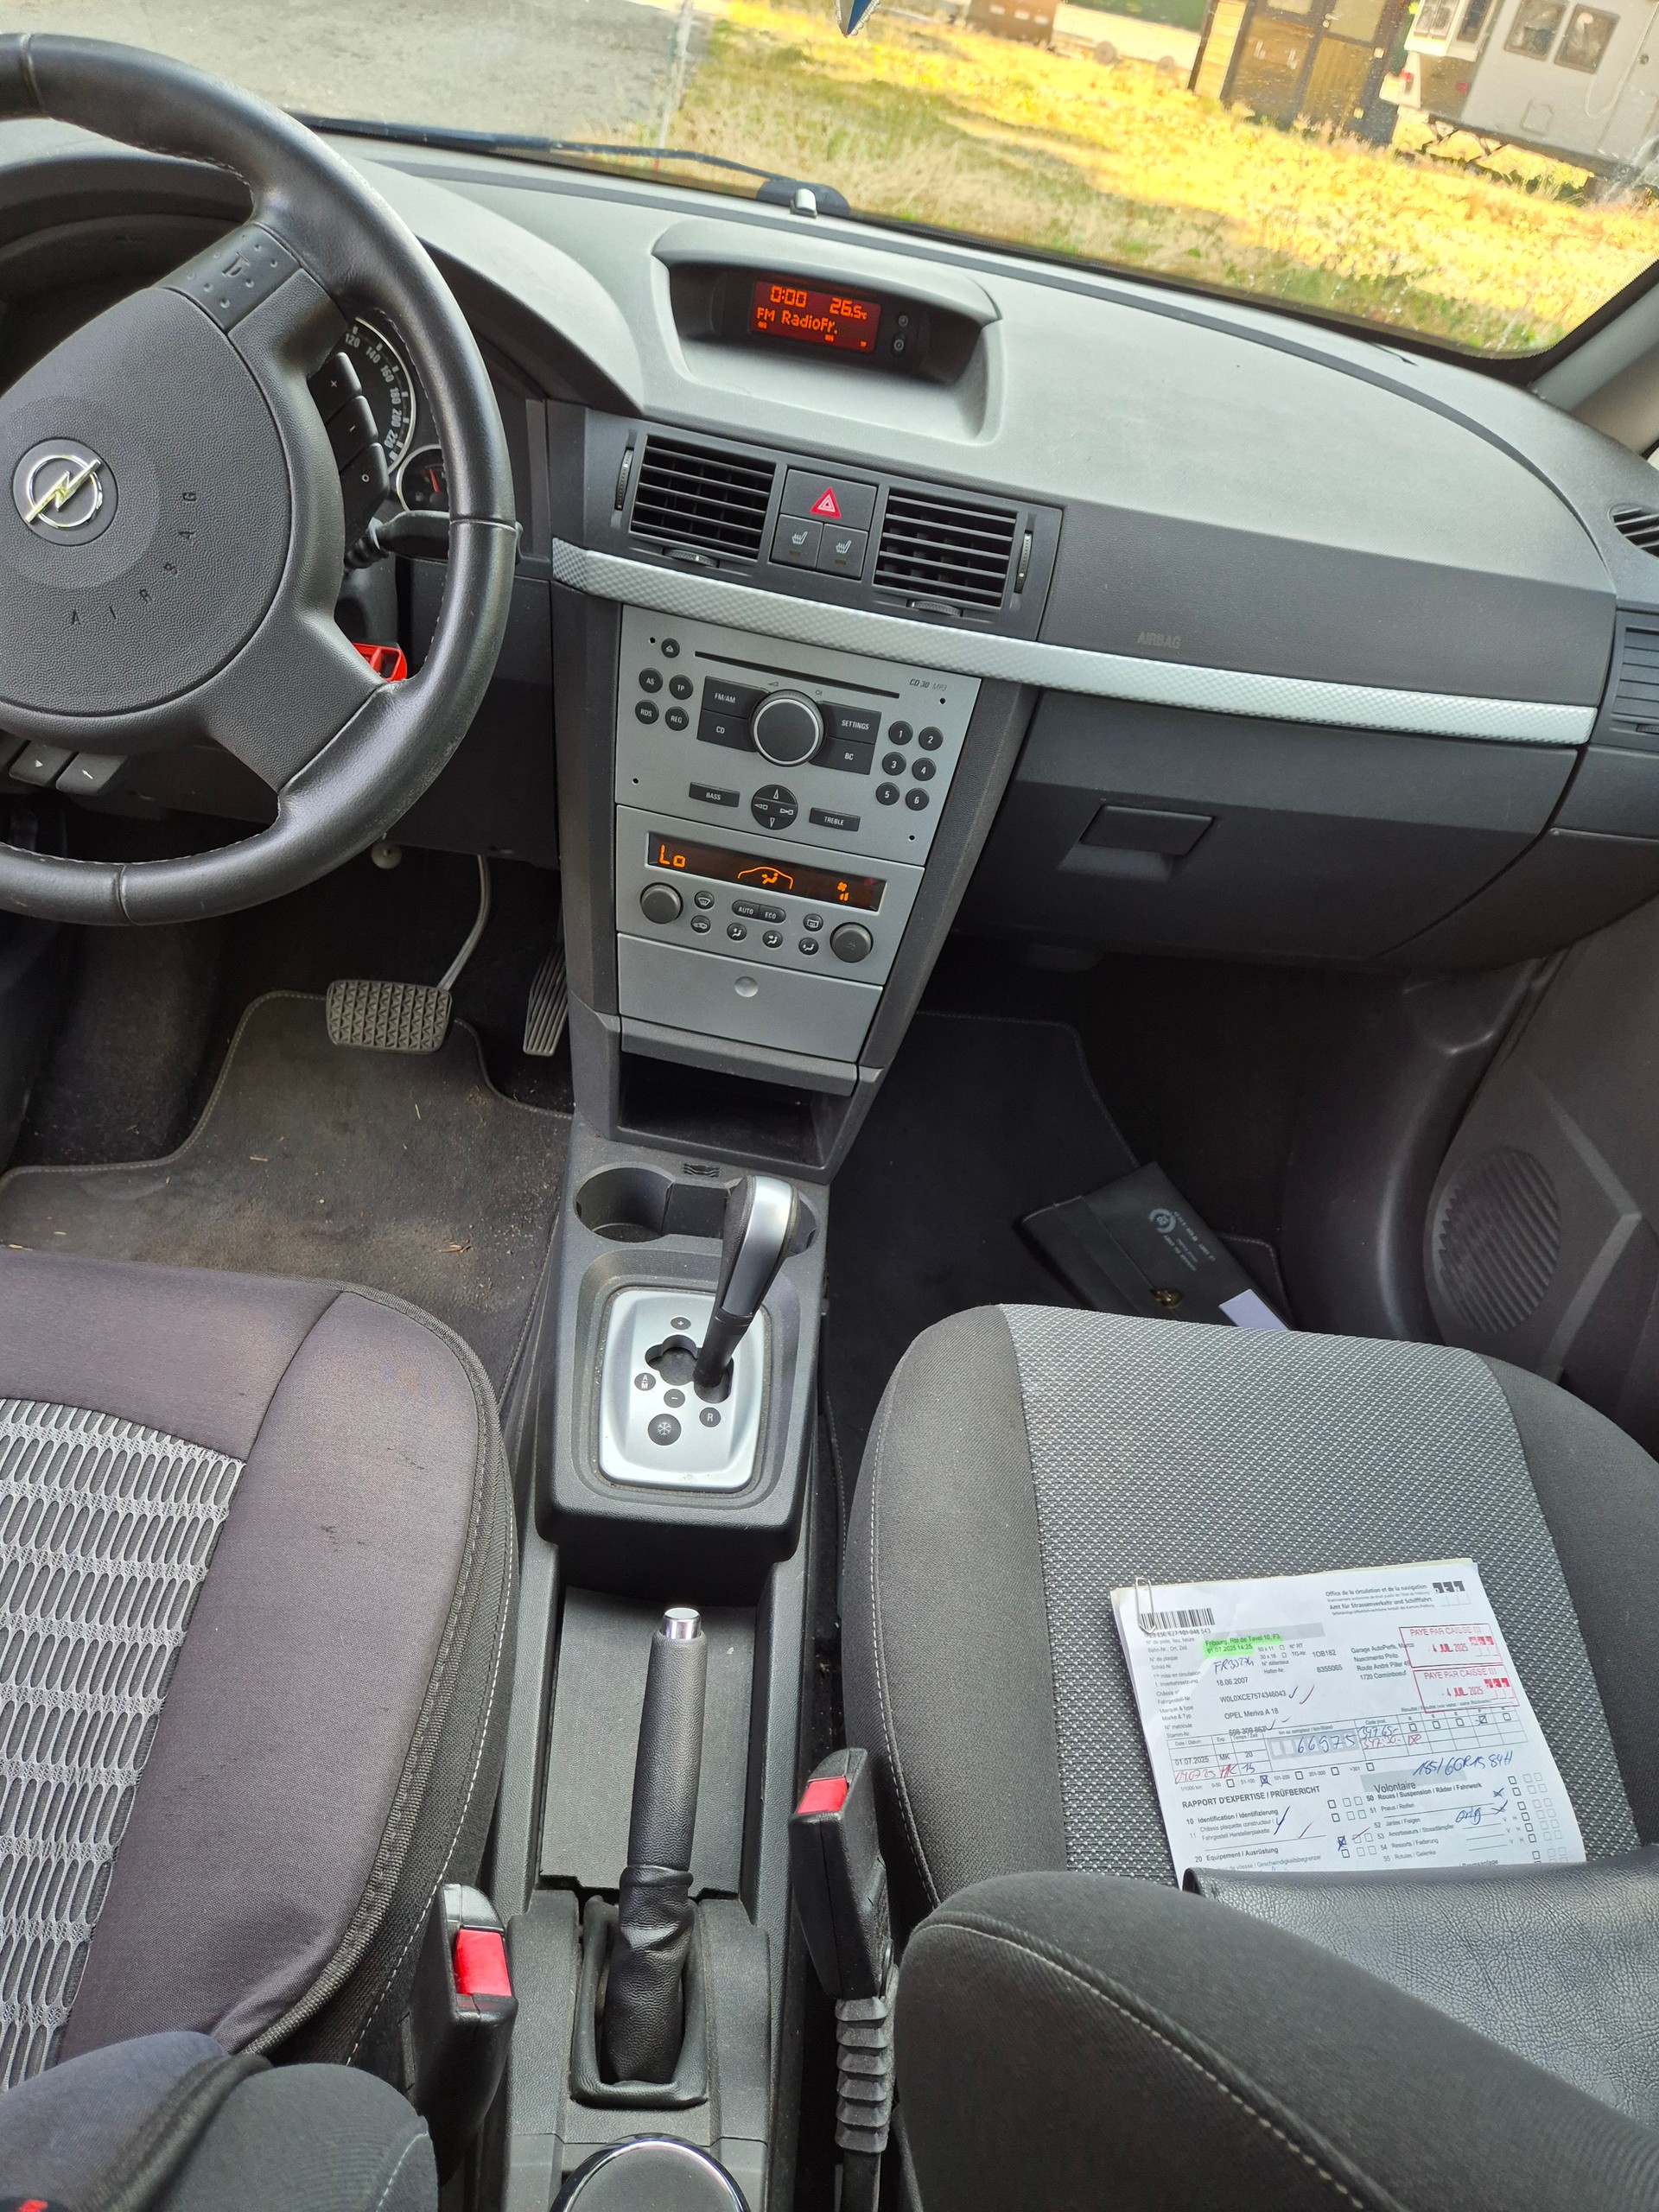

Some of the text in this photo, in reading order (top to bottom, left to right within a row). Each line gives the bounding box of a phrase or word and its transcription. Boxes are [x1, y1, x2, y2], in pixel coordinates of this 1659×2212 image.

[770, 285, 807, 308] 0:00
[757, 307, 776, 321] FM
[346, 334, 360, 347] 120
[366, 346, 381, 364] 140
[380, 365, 394, 383] 160
[390, 387, 401, 404] 180
[391, 408, 402, 428] 200
[384, 429, 397, 448] 220
[1137, 632, 1181, 650] AIRBAG
[932, 683, 947, 691] MP3
[715, 693, 736, 703] FM/AM
[640, 709, 652, 717] RDS
[671, 715, 682, 723] REG
[842, 720, 869, 730] SETTINGS
[706, 791, 721, 800] BASS
[824, 816, 843, 825] TREBLE
[739, 906, 753, 915] AUTO
[765, 911, 777, 919] ECO
[708, 1413, 713, 1421] R
[1325, 1588, 1341, 1597] Office
[1351, 1600, 1392, 1609] Strassenverkehr
[1217, 1677, 1248, 1686] 18.06.2007
[1453, 1687, 1483, 1697] JUL 2025
[1224, 1711, 1243, 1719] OPEL
[1175, 1756, 1209, 1766] 01.07.2025
[1374, 1782, 1416, 1793] Volontaire
[1399, 1789, 1432, 1799] Suspension
[1457, 1782, 1482, 1790] Fahrwerk
[1182, 1786, 1320, 1808] RAPPORT D'EXPERTISE PRÜFBERICHT
[1198, 1814, 1235, 1823] Identification
[1239, 1808, 1278, 1818] Identifizierung
[1206, 1853, 1241, 1862] Equipement
[1245, 1847, 1278, 1856] Ausrüstung
